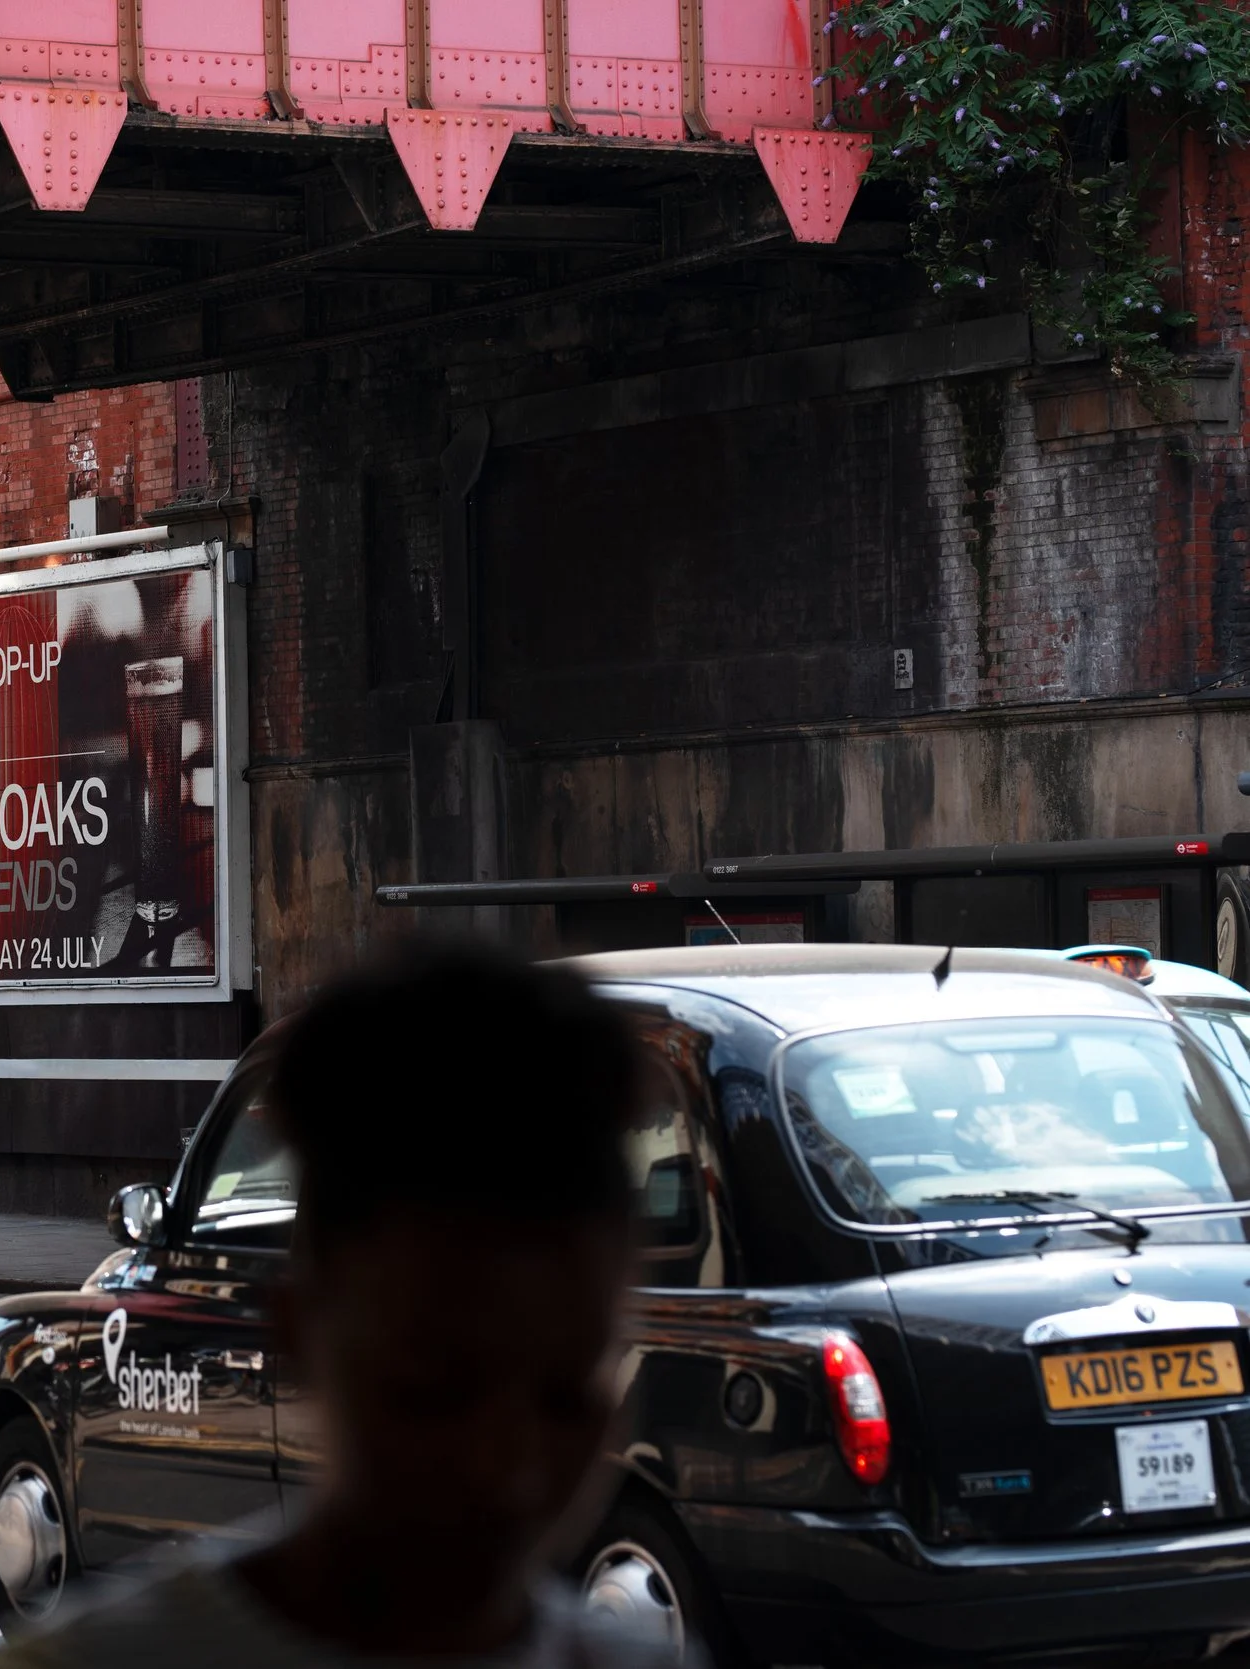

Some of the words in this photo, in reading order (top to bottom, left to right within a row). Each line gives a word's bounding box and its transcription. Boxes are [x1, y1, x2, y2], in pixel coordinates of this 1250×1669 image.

[0, 776, 108, 850] OAKS
[30, 937, 52, 969] 24
[56, 936, 105, 969] JULY
[118, 1350, 202, 1415] sherbet
[1064, 1355, 1145, 1398] KD16
[1151, 1350, 1219, 1389] PZS
[1137, 1452, 1195, 1477] 59189
